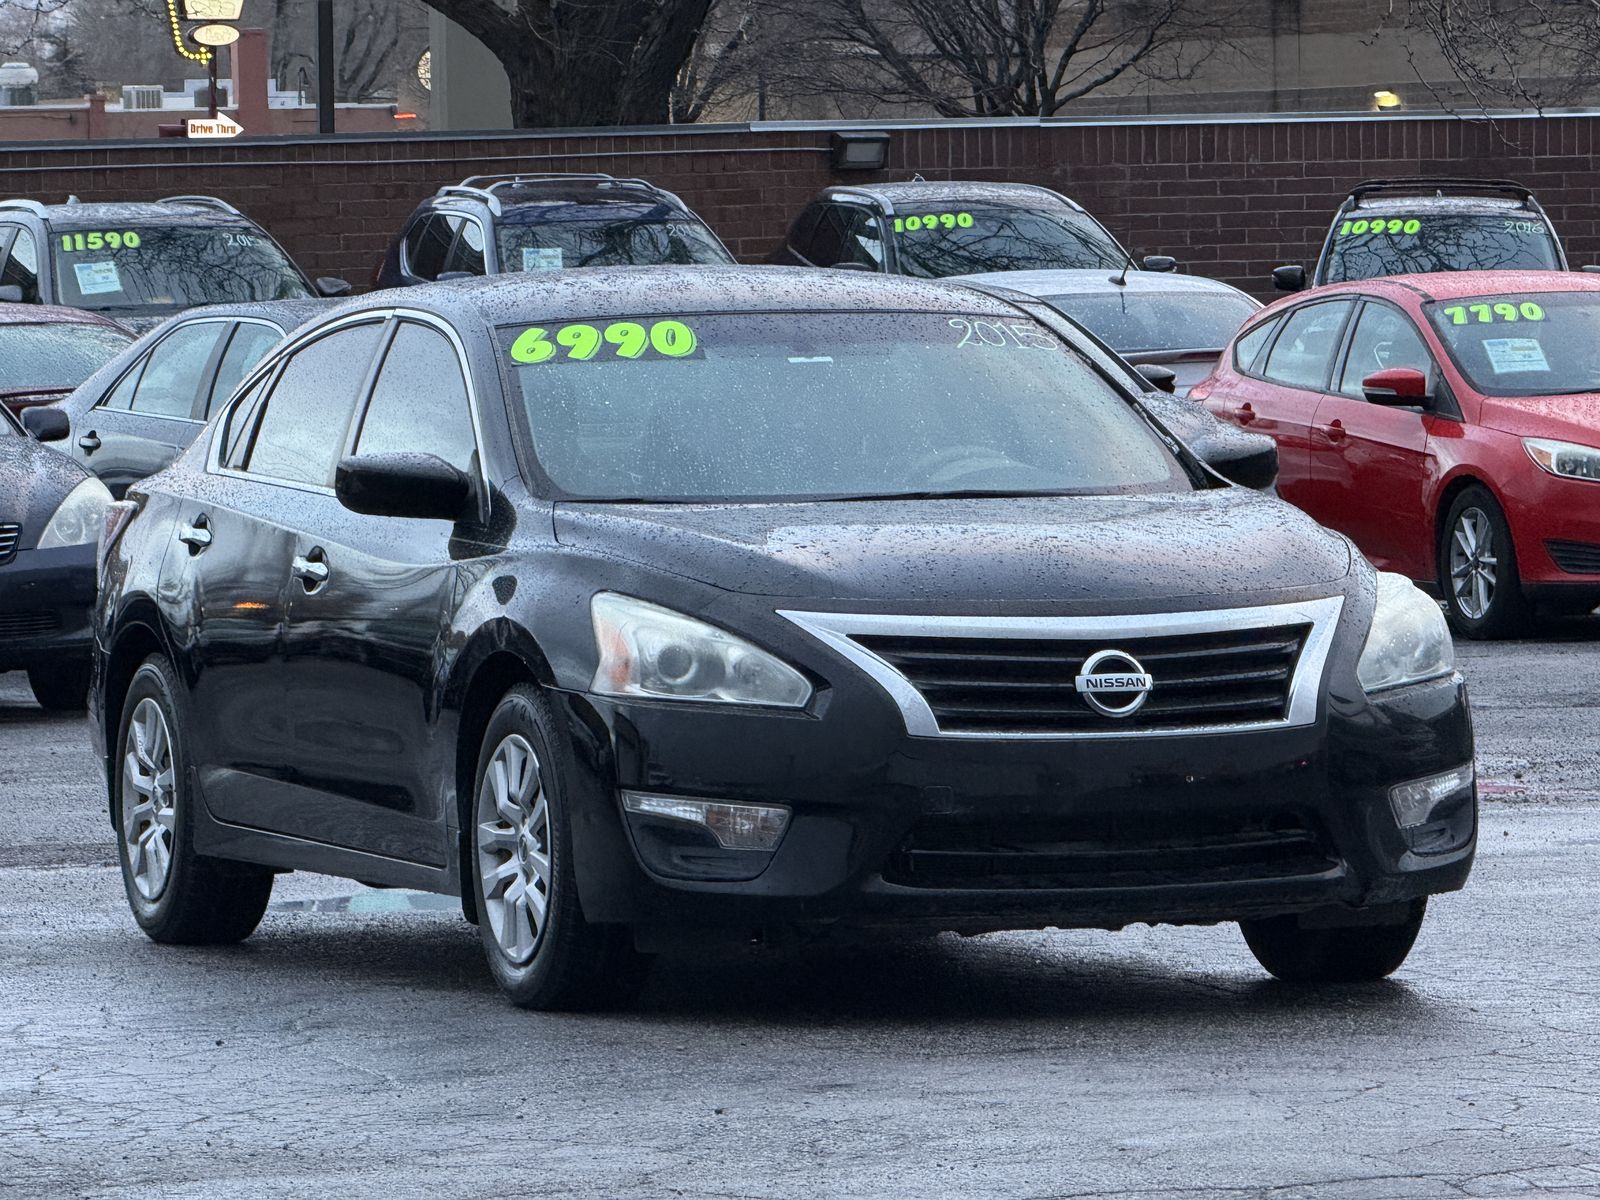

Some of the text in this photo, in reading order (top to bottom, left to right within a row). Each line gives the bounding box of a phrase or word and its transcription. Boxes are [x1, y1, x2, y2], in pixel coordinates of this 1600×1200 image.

[190, 124, 237, 134] Drive Thru
[894, 212, 974, 233] 10990
[1339, 219, 1422, 236] 10990
[1503, 220, 1545, 234] 2016
[62, 231, 141, 252] 11590
[1444, 302, 1545, 324] 7790
[510, 320, 697, 364] 6990
[948, 319, 1058, 351] 2015
[1086, 677, 1147, 689] NISSAN
